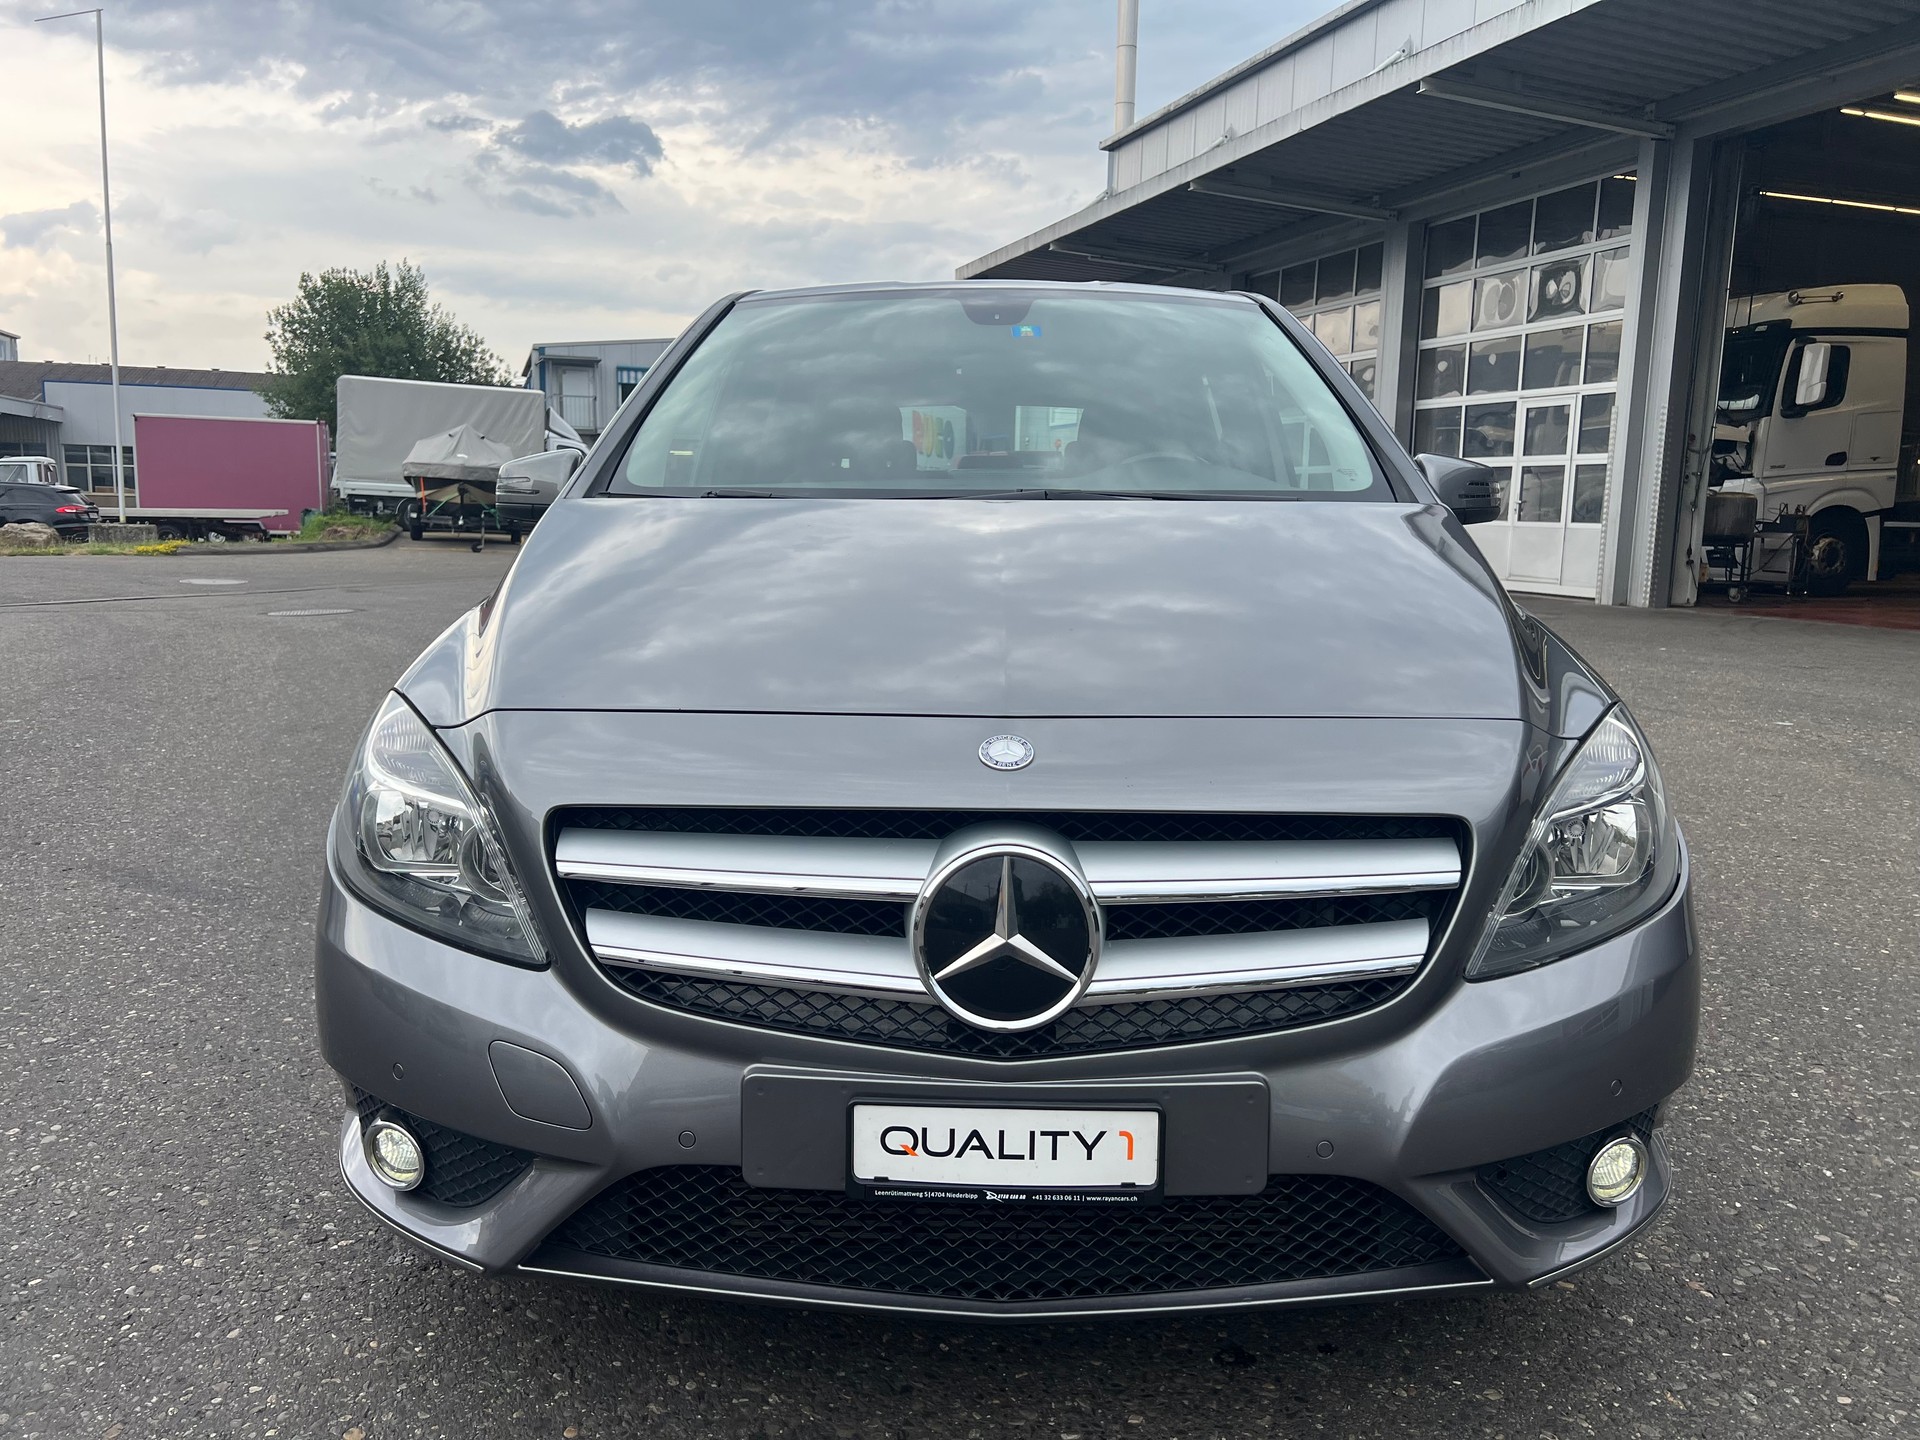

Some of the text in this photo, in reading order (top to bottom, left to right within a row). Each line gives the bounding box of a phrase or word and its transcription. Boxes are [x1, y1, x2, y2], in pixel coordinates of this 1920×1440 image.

[880, 1125, 1134, 1161] QUALITY 1
[1086, 1195, 1138, 1203] www.rayancars.ch
